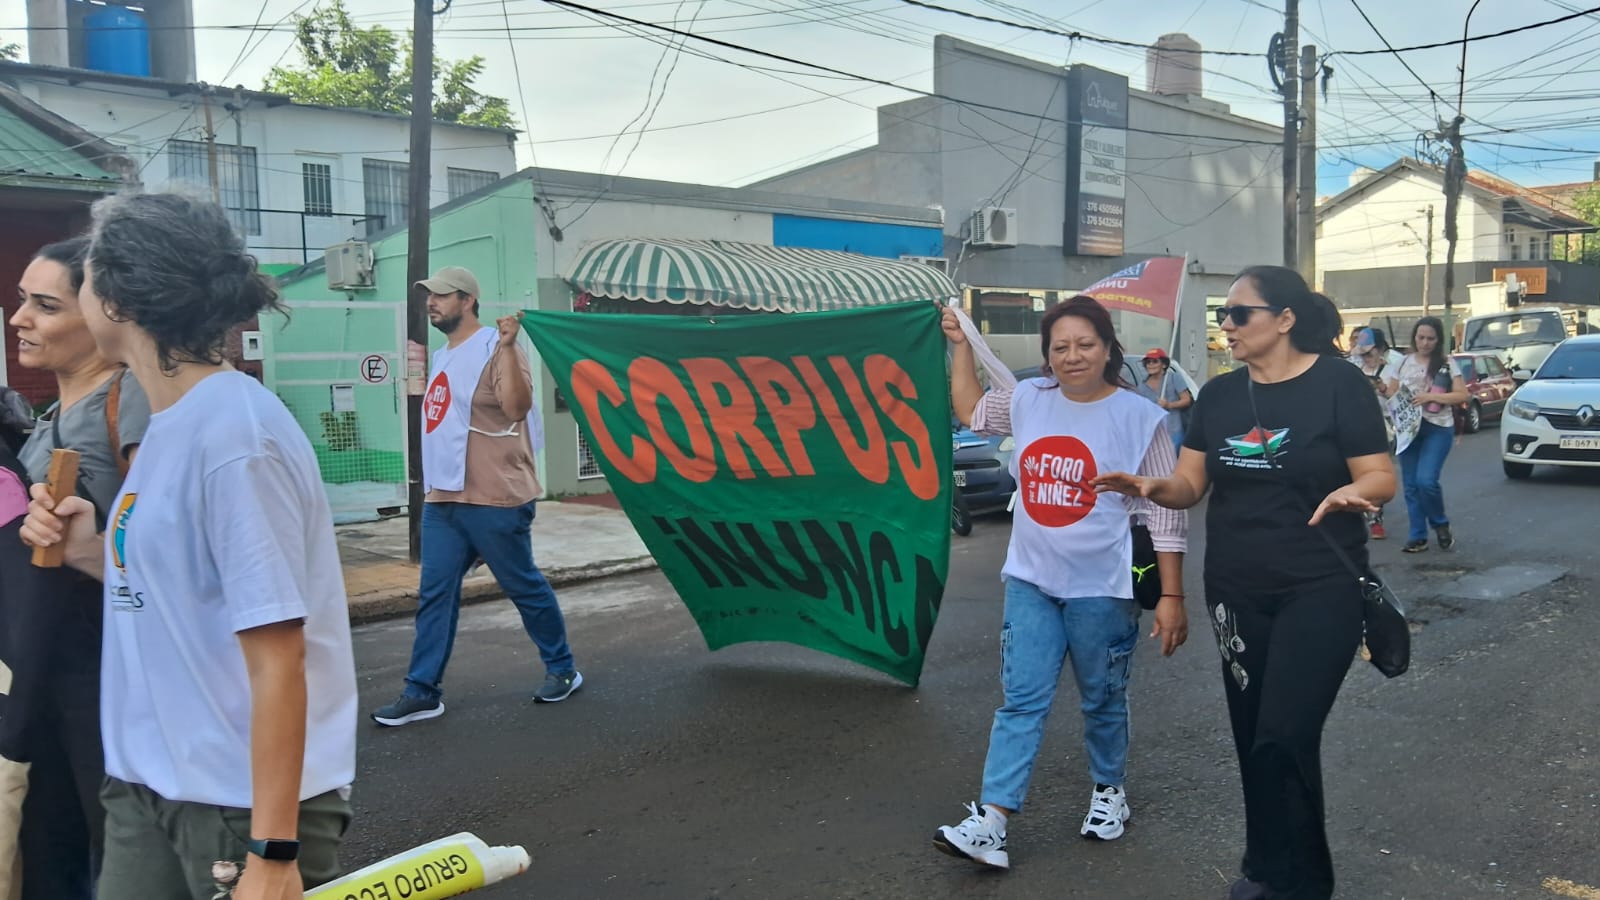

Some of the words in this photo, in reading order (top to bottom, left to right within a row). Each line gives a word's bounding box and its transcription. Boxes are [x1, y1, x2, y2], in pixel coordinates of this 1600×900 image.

[368, 359, 382, 378] E
[570, 353, 940, 500] CORPUS
[1039, 453, 1085, 483] FORO
[1037, 480, 1083, 507] NIÑEZ
[395, 854, 467, 898] GRUPO
